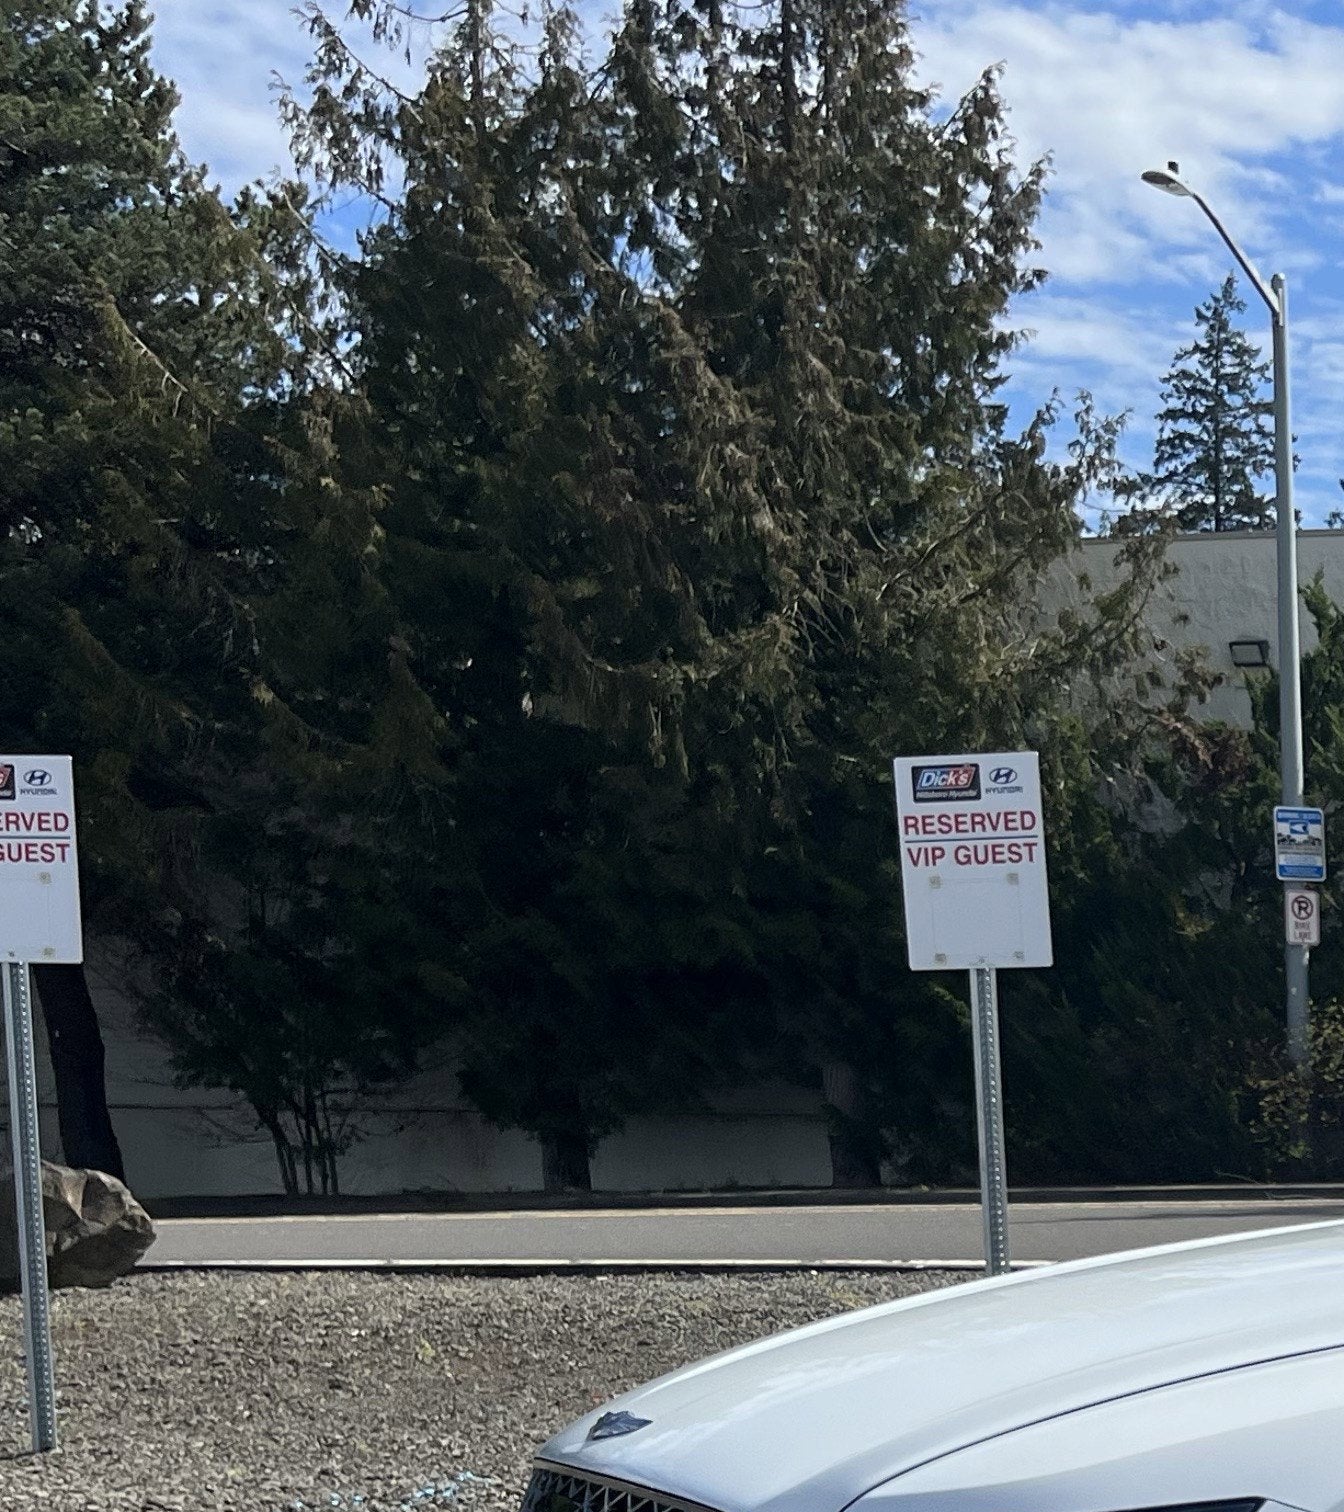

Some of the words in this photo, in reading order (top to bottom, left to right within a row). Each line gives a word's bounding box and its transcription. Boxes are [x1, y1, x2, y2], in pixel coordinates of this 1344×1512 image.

[0, 811, 69, 832] RVED
[903, 810, 1037, 836] RESERVED
[0, 842, 70, 863] UEST
[907, 846, 946, 867] VIP
[954, 842, 1038, 866] GUEST
